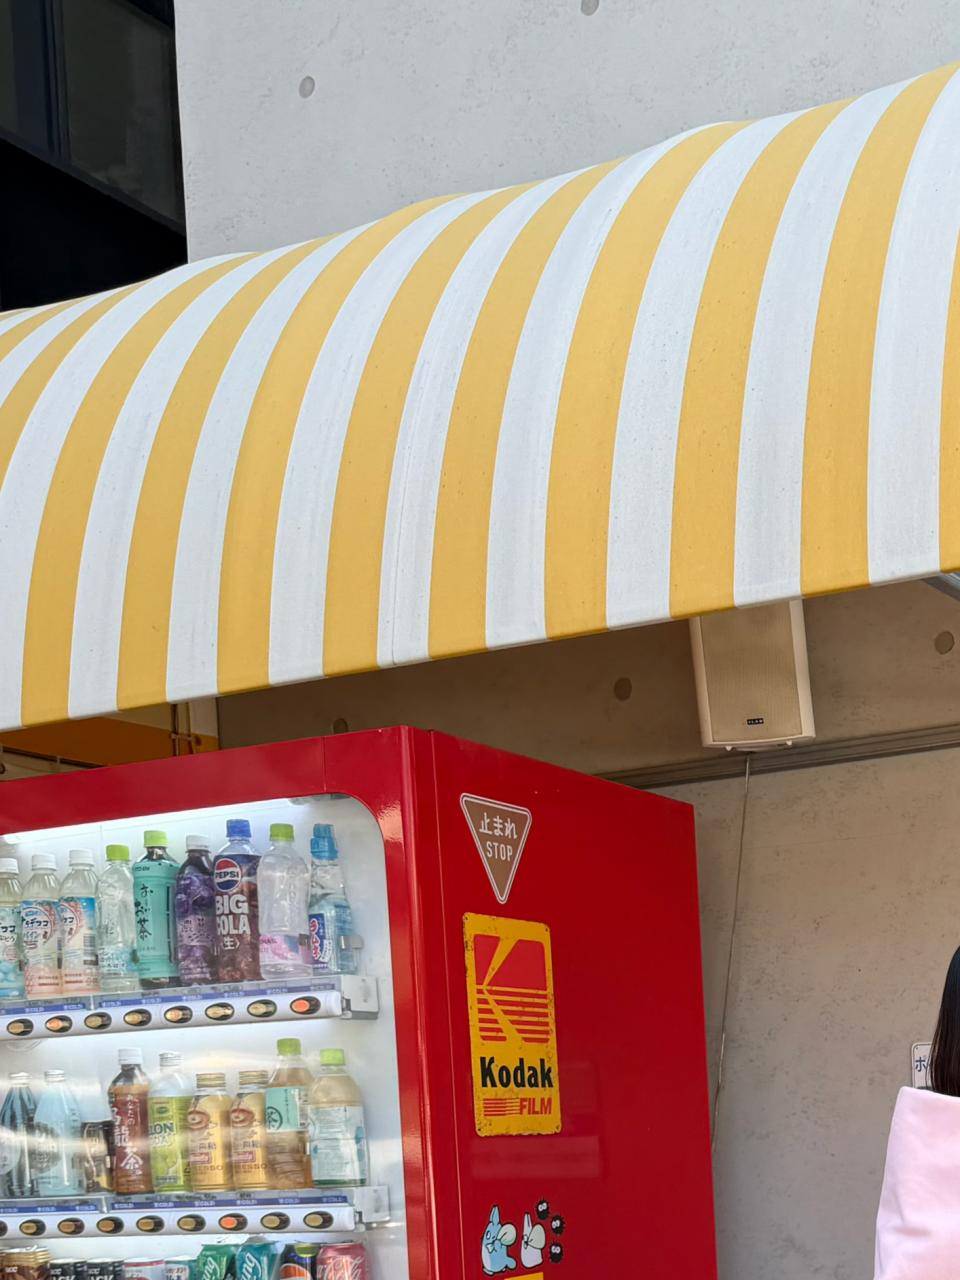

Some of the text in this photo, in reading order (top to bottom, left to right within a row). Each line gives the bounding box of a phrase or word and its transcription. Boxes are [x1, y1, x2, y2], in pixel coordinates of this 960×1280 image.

[479, 811, 518, 839] 止まれ
[486, 841, 513, 861] STOP
[216, 894, 249, 914] BIG
[479, 1056, 554, 1088] Kodak
[519, 1097, 553, 1115] FILM
[150, 1122, 175, 1135] LON
